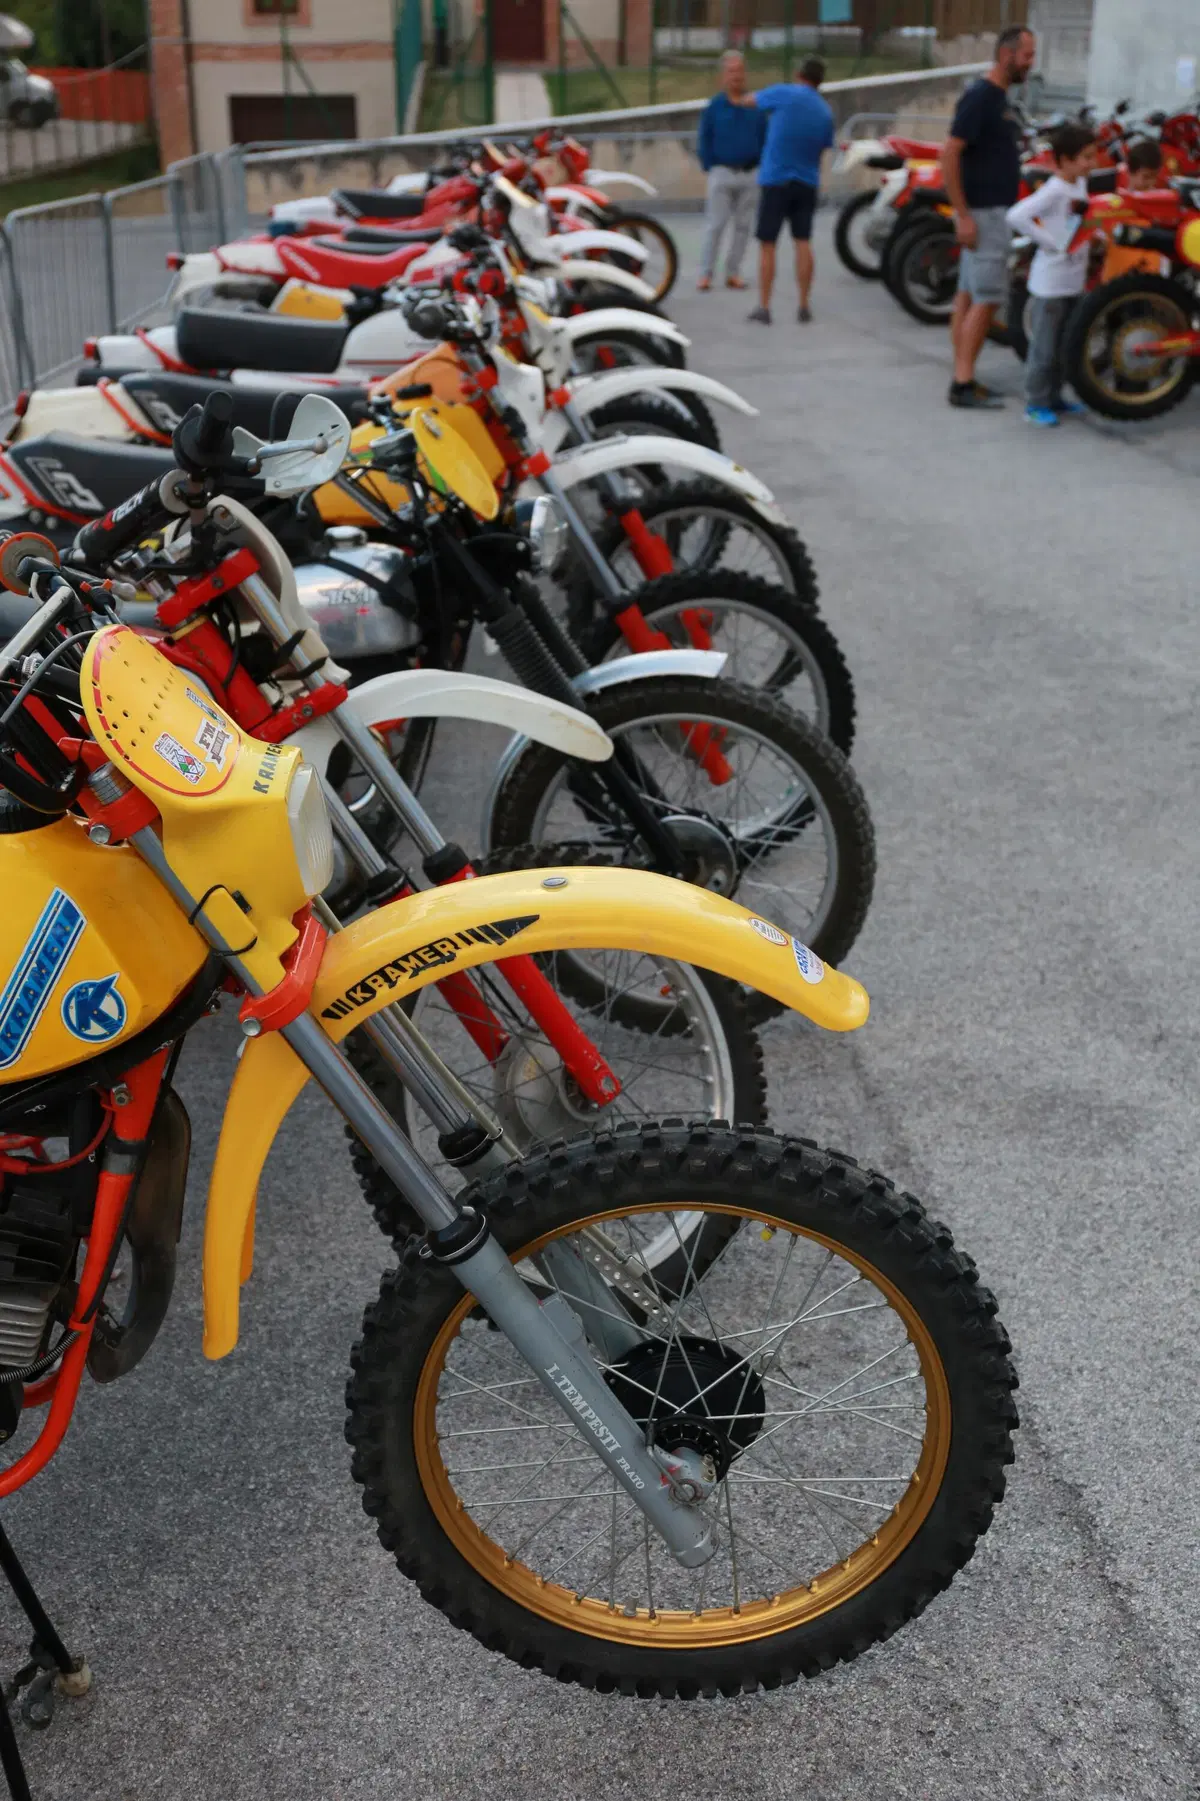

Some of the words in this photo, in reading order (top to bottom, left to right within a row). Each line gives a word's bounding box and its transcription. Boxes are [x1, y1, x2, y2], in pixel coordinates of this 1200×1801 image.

[199, 722, 216, 749] FM
[0, 921, 71, 1053] KRAMER
[347, 940, 457, 1004] KRAMER
[555, 1375, 621, 1453] TEMPESTI
[616, 1457, 645, 1489] PRATO
